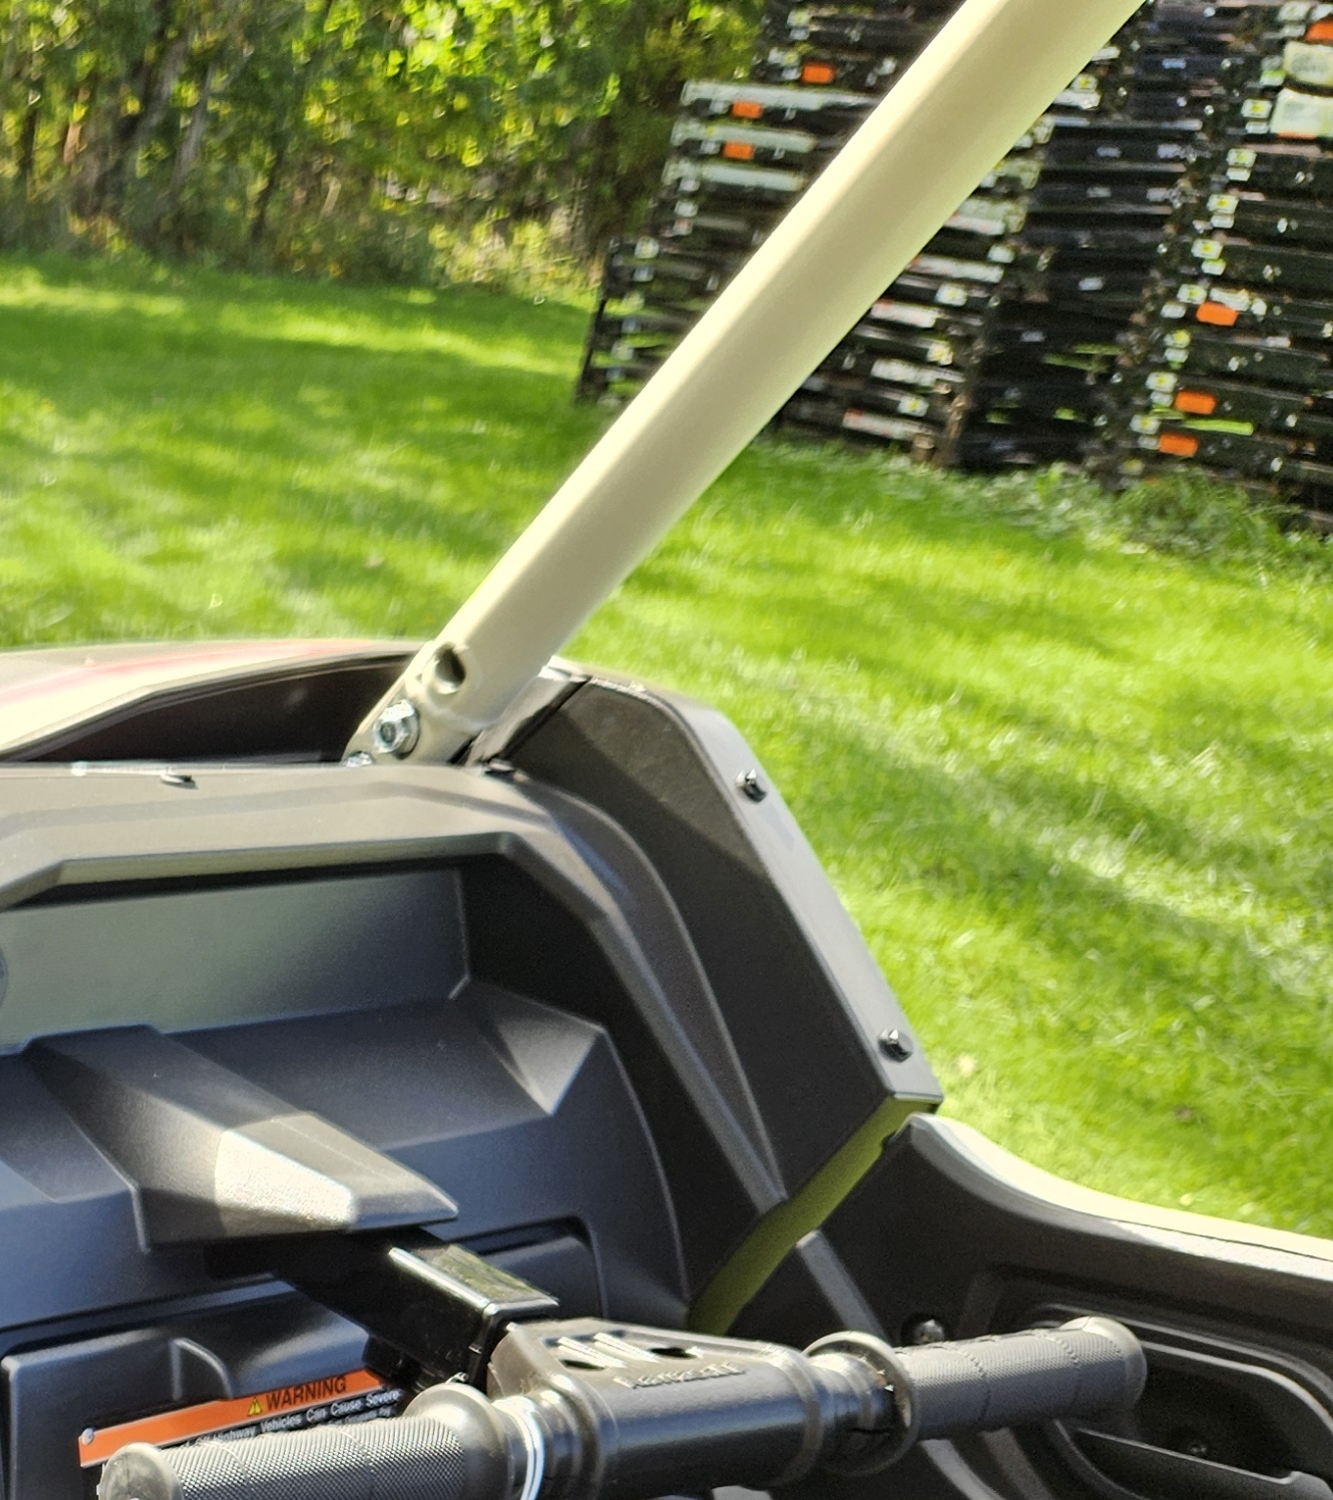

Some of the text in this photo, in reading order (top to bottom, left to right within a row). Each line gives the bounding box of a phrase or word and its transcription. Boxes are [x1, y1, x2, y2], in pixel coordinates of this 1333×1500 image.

[260, 1413, 302, 1433] Vehicles
[306, 1406, 327, 1422] Can
[330, 1397, 363, 1417] Cause
[366, 1388, 402, 1408] Severe
[266, 1376, 347, 1411] WARNING
